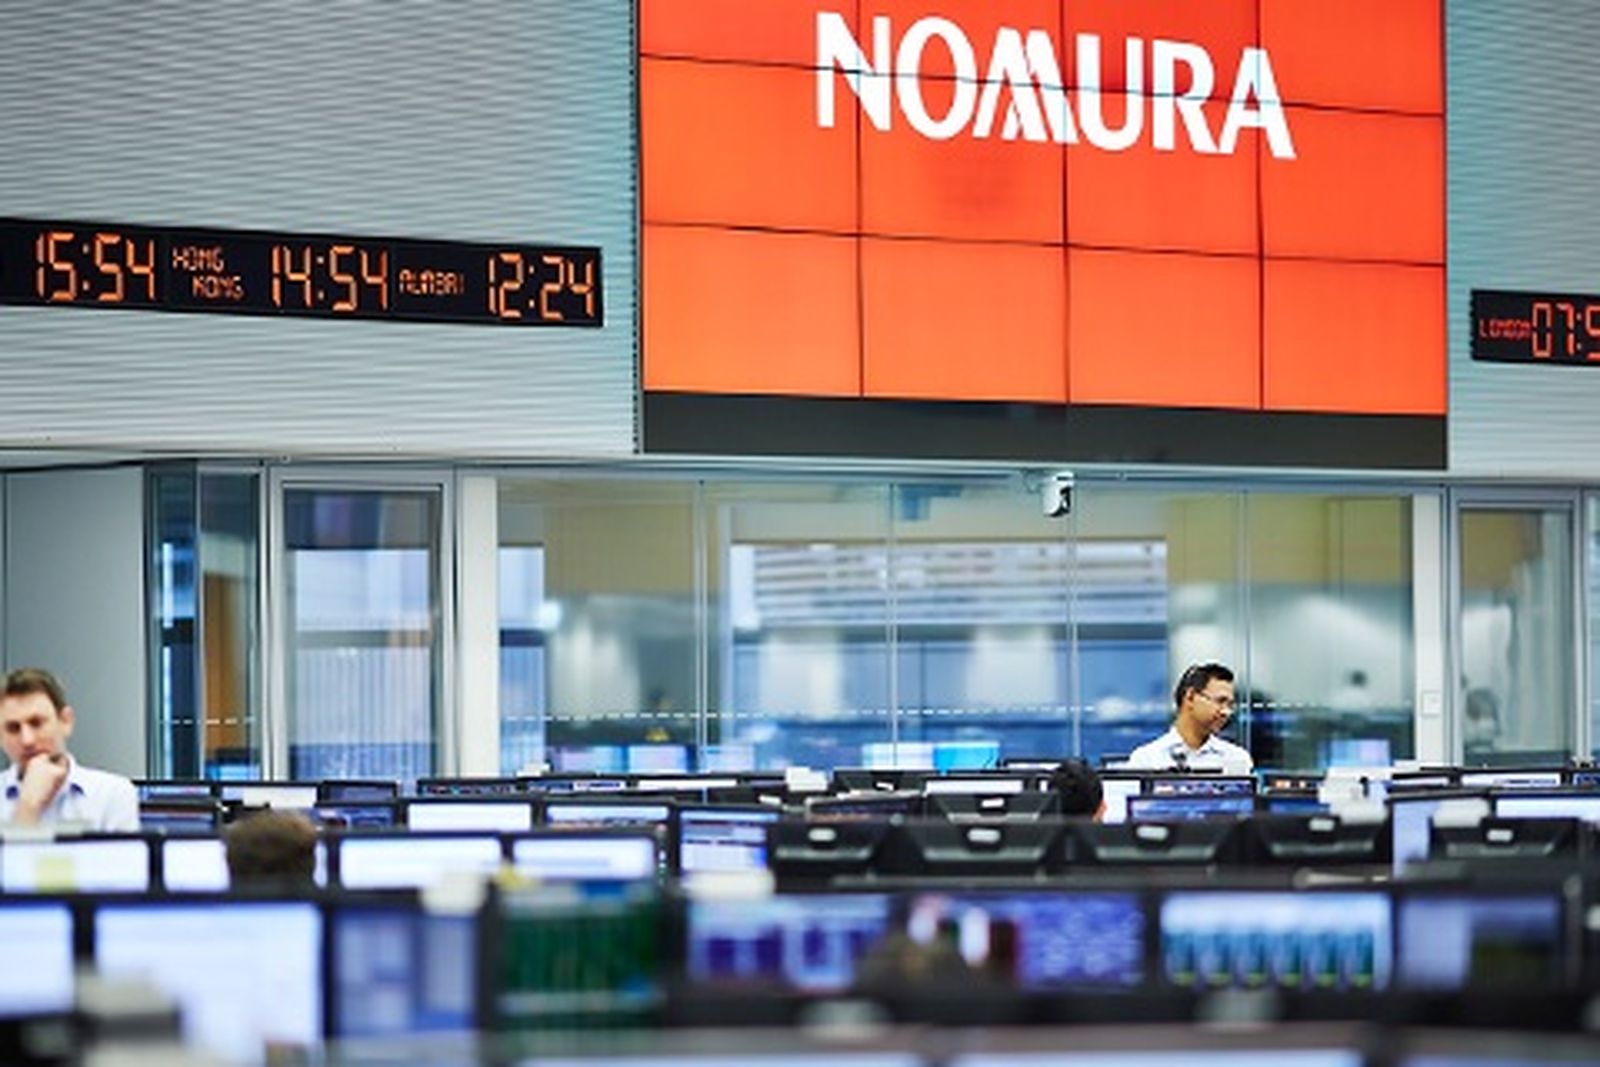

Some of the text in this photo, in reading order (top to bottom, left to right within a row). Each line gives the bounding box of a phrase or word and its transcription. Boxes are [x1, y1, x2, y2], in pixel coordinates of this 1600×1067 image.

[816, 11, 1297, 159] NOMURA
[36, 232, 155, 301] 15:54
[272, 245, 388, 312] 14:54
[489, 253, 594, 320] 12:24
